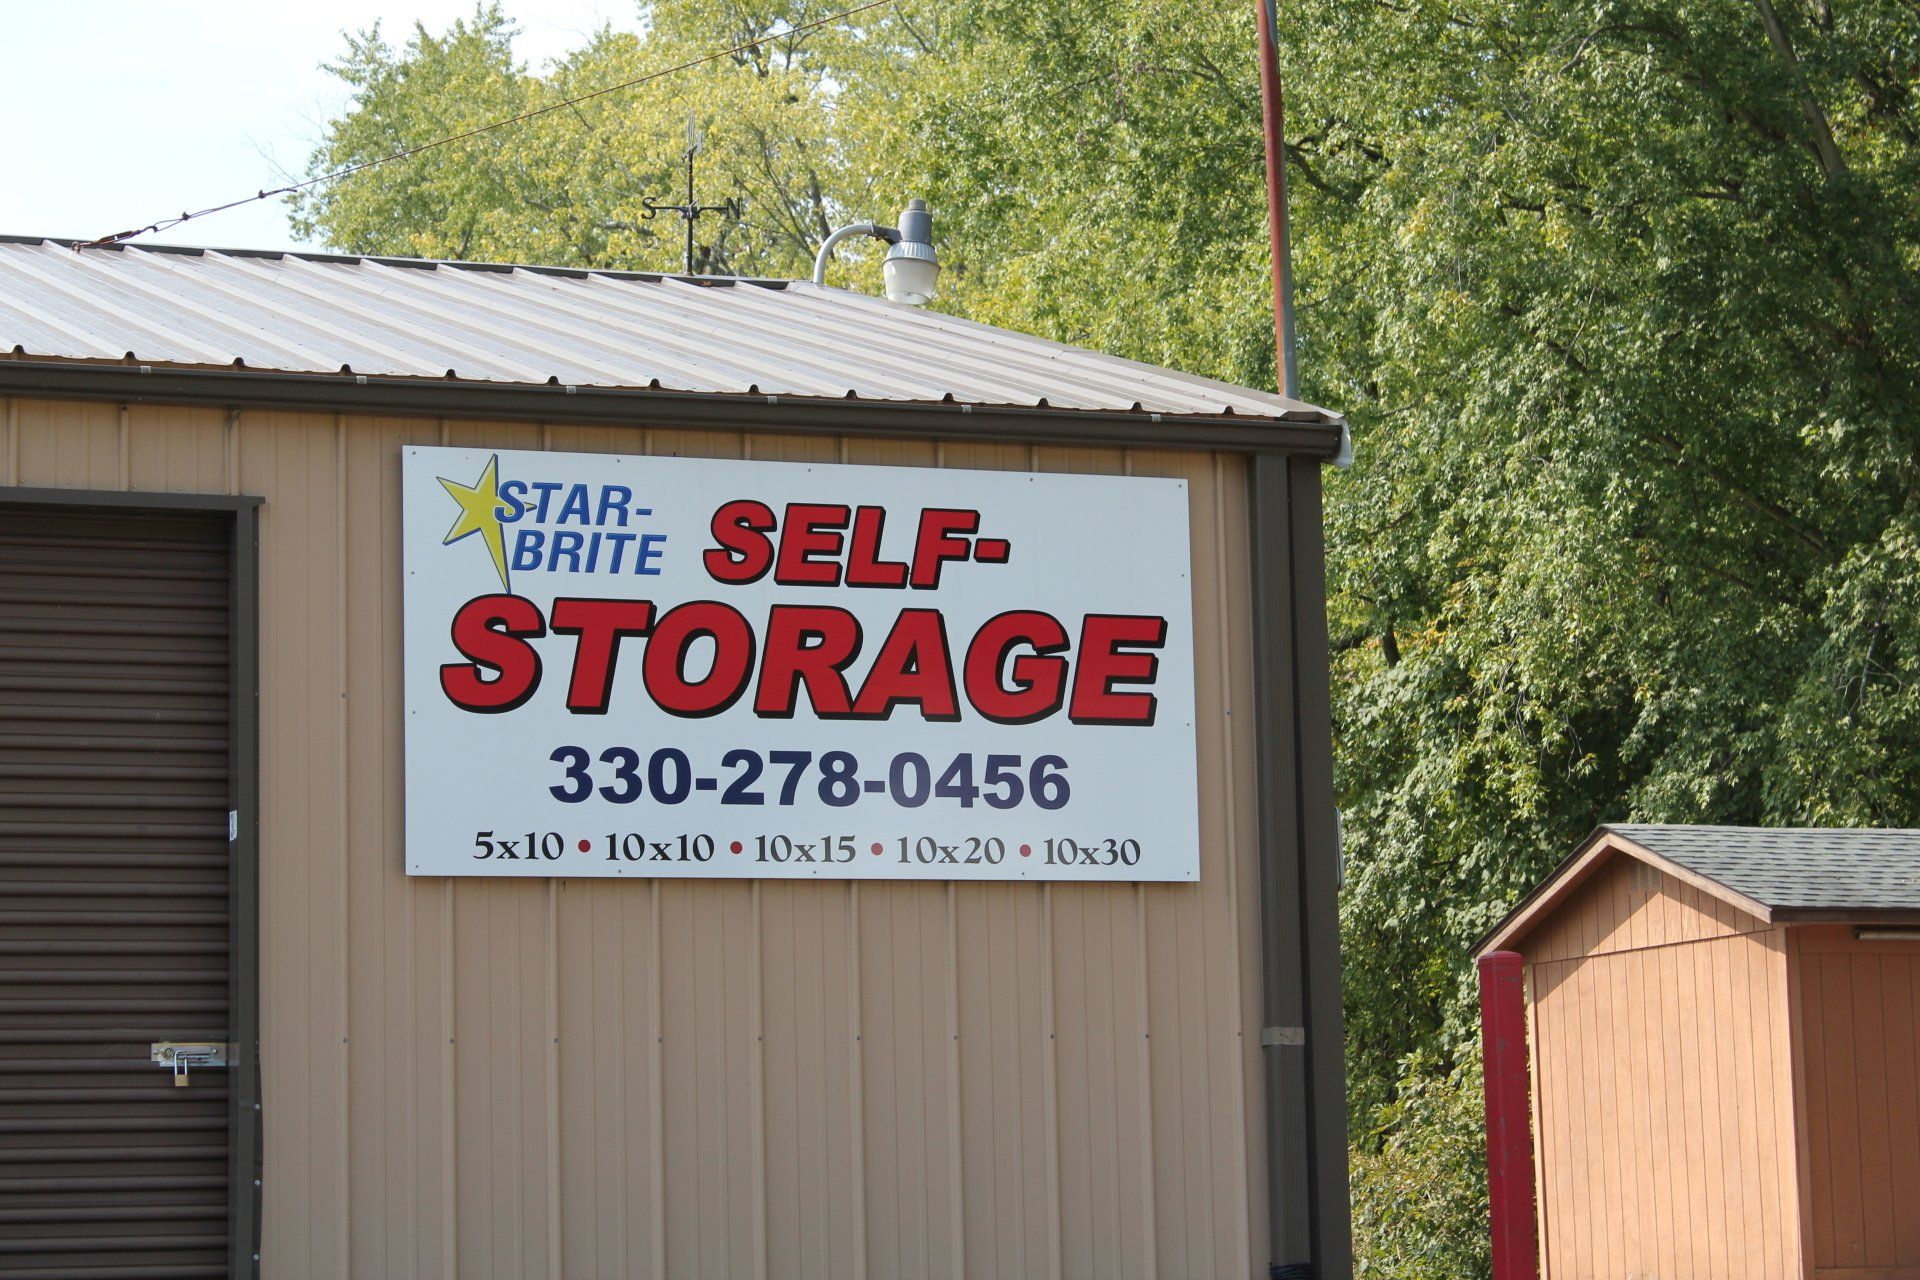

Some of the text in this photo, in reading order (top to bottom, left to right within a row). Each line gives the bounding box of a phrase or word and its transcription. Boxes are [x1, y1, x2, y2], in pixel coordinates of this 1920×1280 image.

[640, 196, 657, 220] S
[725, 196, 742, 220] N
[494, 480, 653, 527] STAR-
[511, 529, 668, 575] BRITE
[703, 499, 1011, 590] SELF-
[440, 593, 1168, 727] STORAGE
[549, 746, 1071, 810] 330-278-0456
[473, 831, 1141, 866] 5x10 10x10 10x15 10x20 10x30
